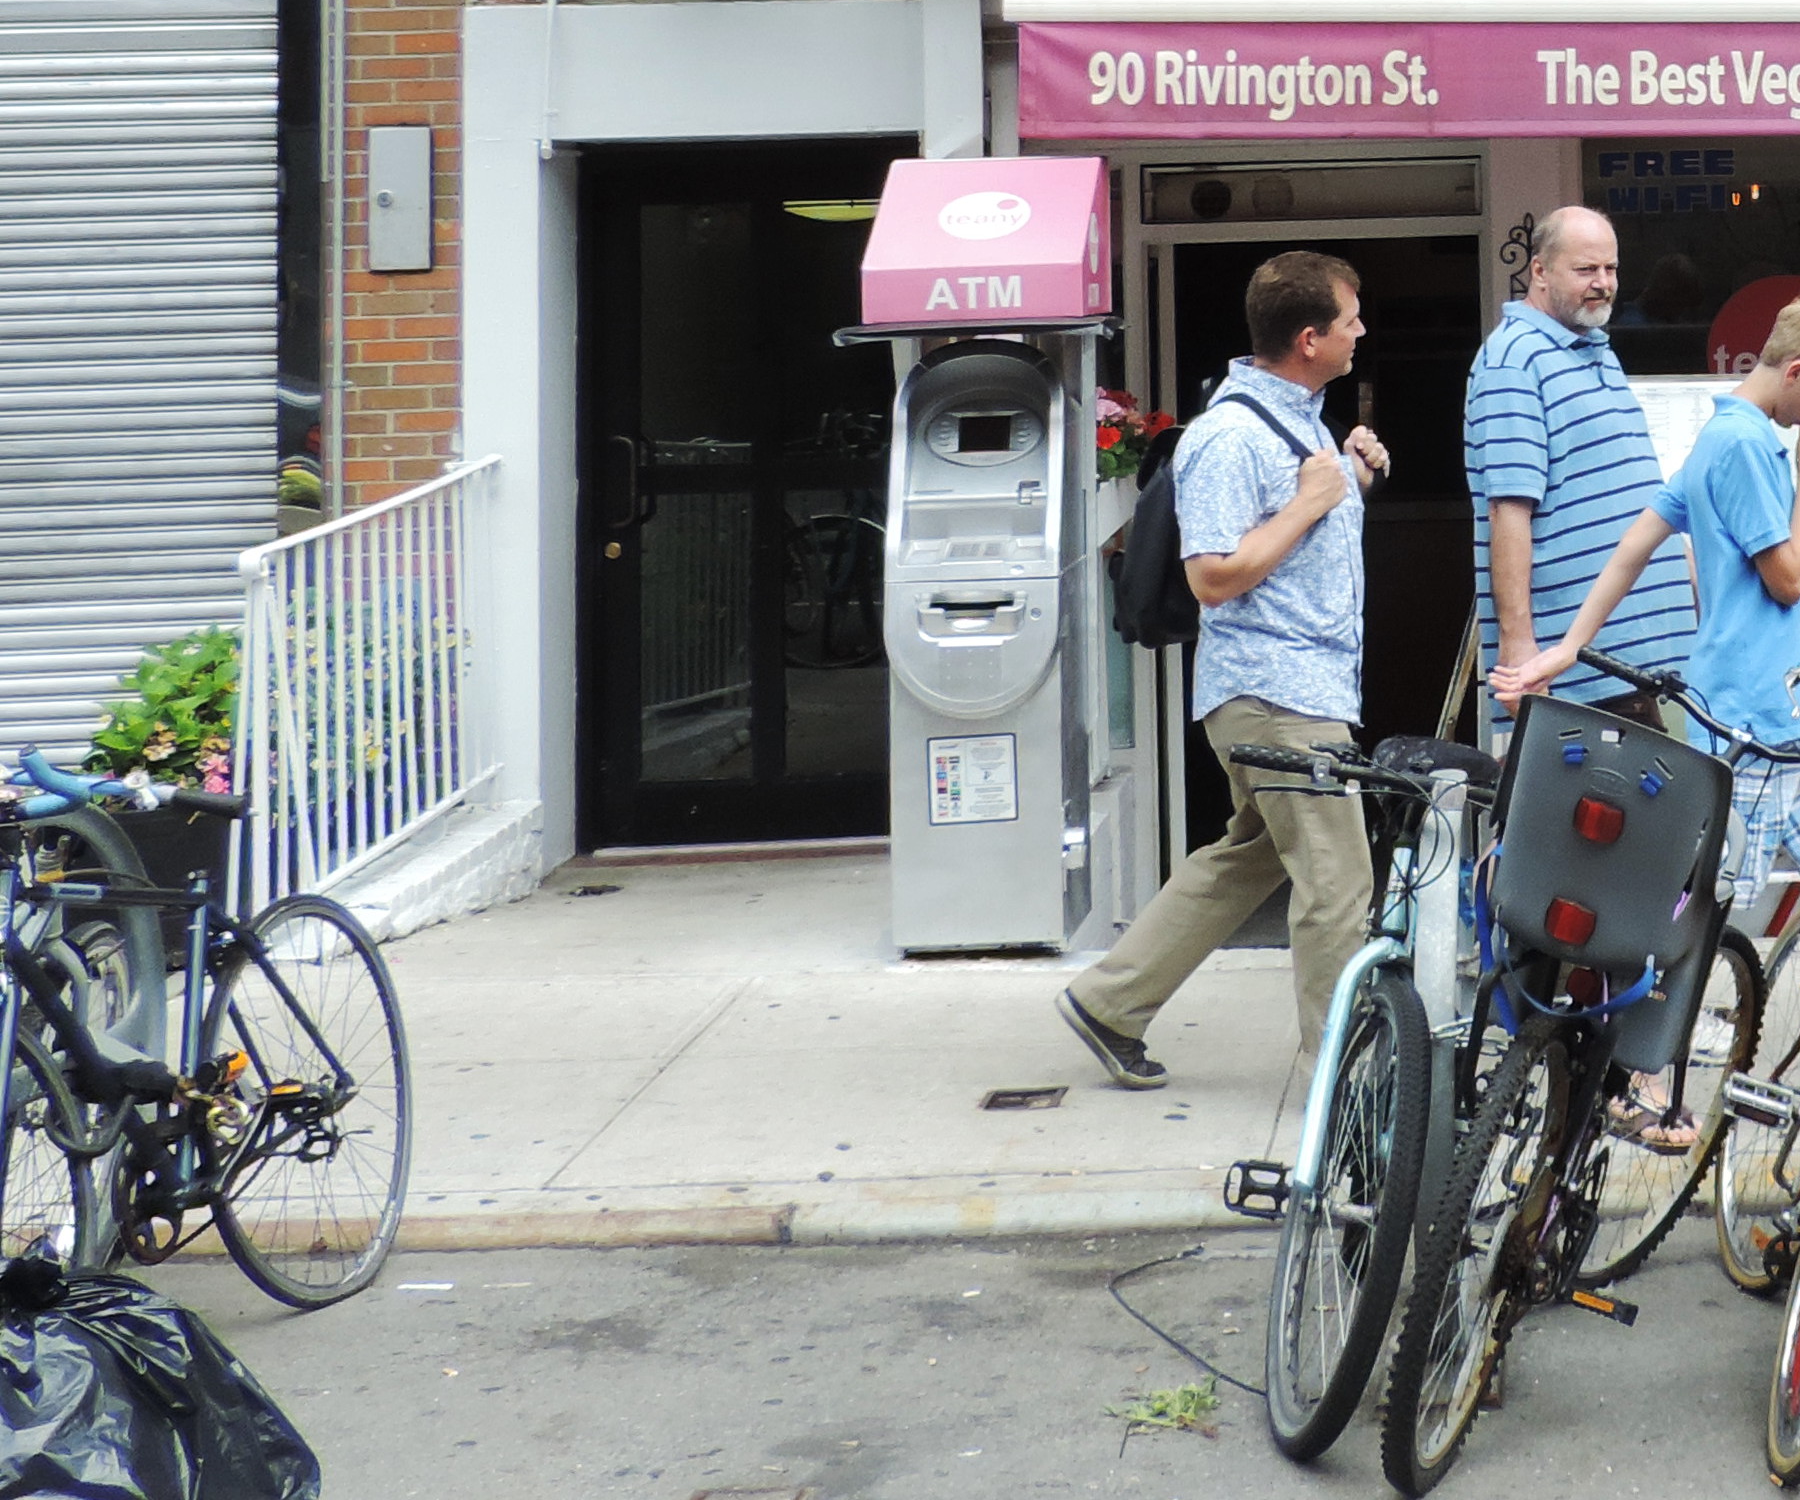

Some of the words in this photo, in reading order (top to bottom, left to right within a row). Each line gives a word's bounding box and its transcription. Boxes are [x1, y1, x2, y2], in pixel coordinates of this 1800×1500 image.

[1087, 50, 1146, 106] 90
[1154, 49, 1373, 122] Rivington
[1381, 49, 1441, 106] St.
[1536, 47, 1620, 106] The
[1629, 50, 1726, 105] Best
[1597, 148, 1736, 178] FREE
[1607, 183, 1727, 213] WI-FI
[946, 213, 1024, 226] teany
[925, 274, 1022, 311] ATM
